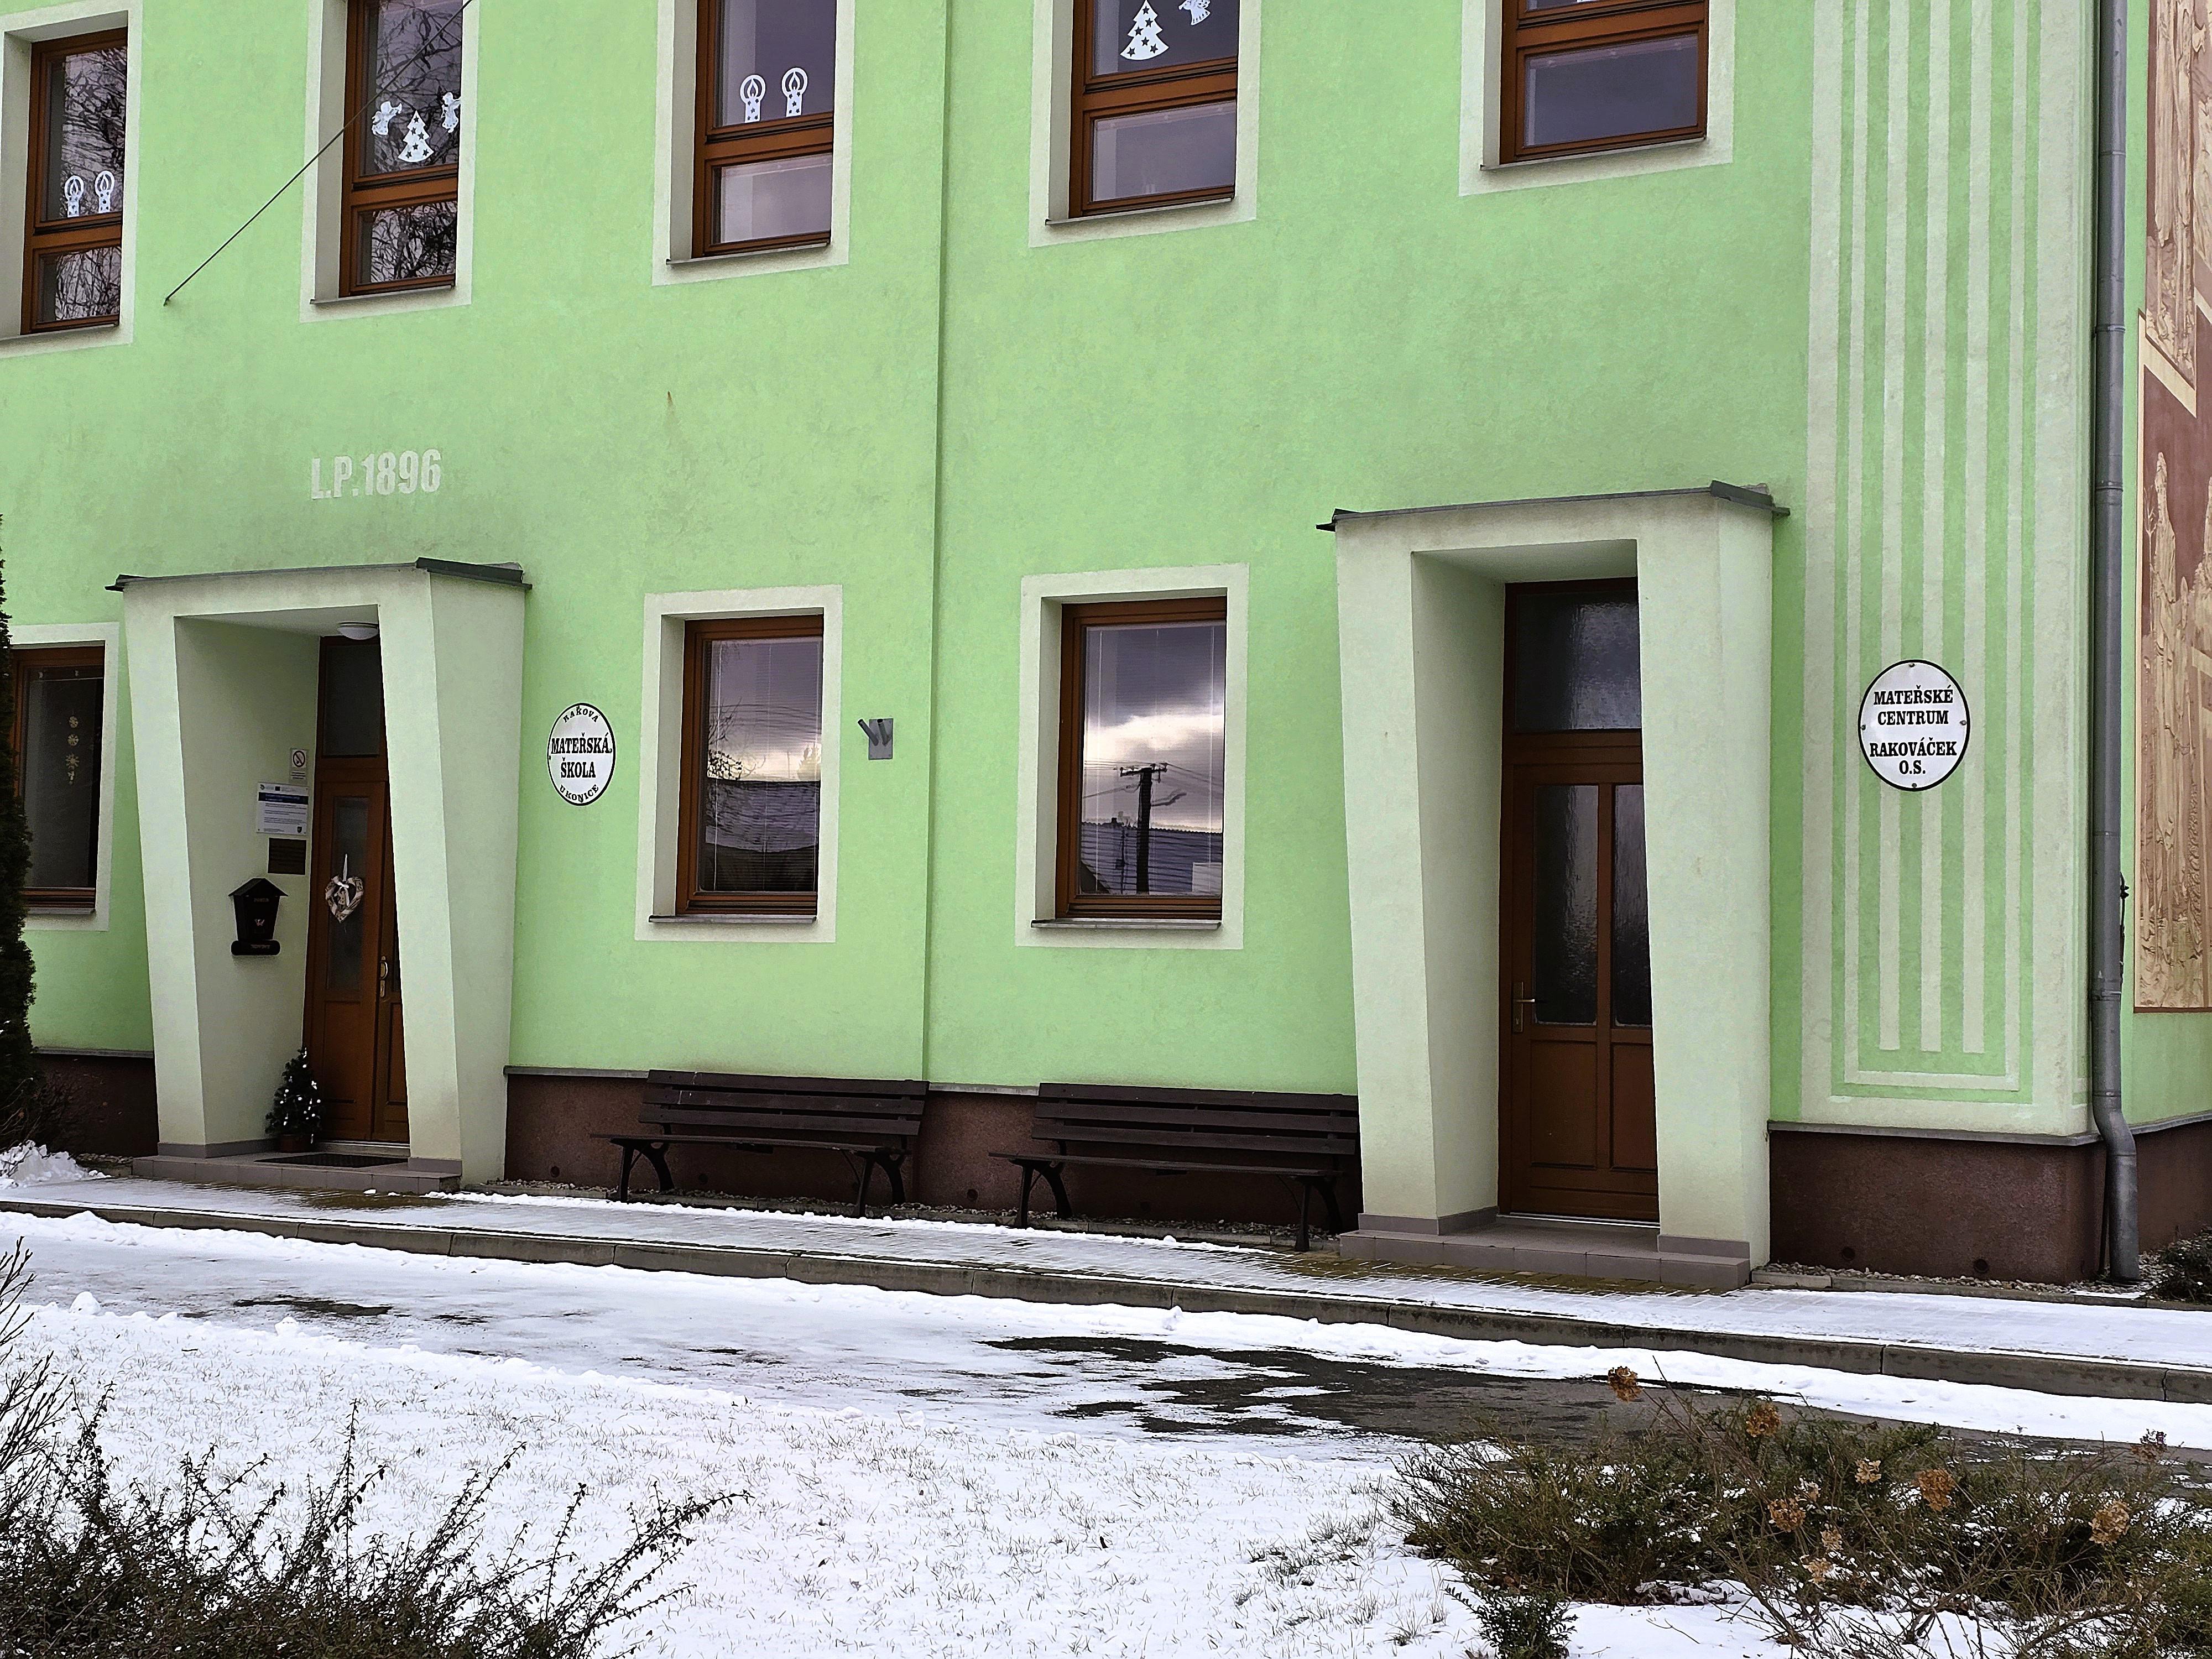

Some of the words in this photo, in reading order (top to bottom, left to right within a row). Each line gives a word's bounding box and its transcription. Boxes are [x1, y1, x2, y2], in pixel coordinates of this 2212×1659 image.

[311, 448, 441, 499] L.P.1896
[1874, 685, 1953, 705] MATEŘSKÉ
[1877, 710, 1949, 725] CENTRUM
[551, 732, 609, 754] MATEŘSKÁ
[1870, 737, 1957, 757] RAKOVÁČEK
[561, 757, 596, 778] ŠKOLA
[1899, 760, 1926, 774] O.S.
